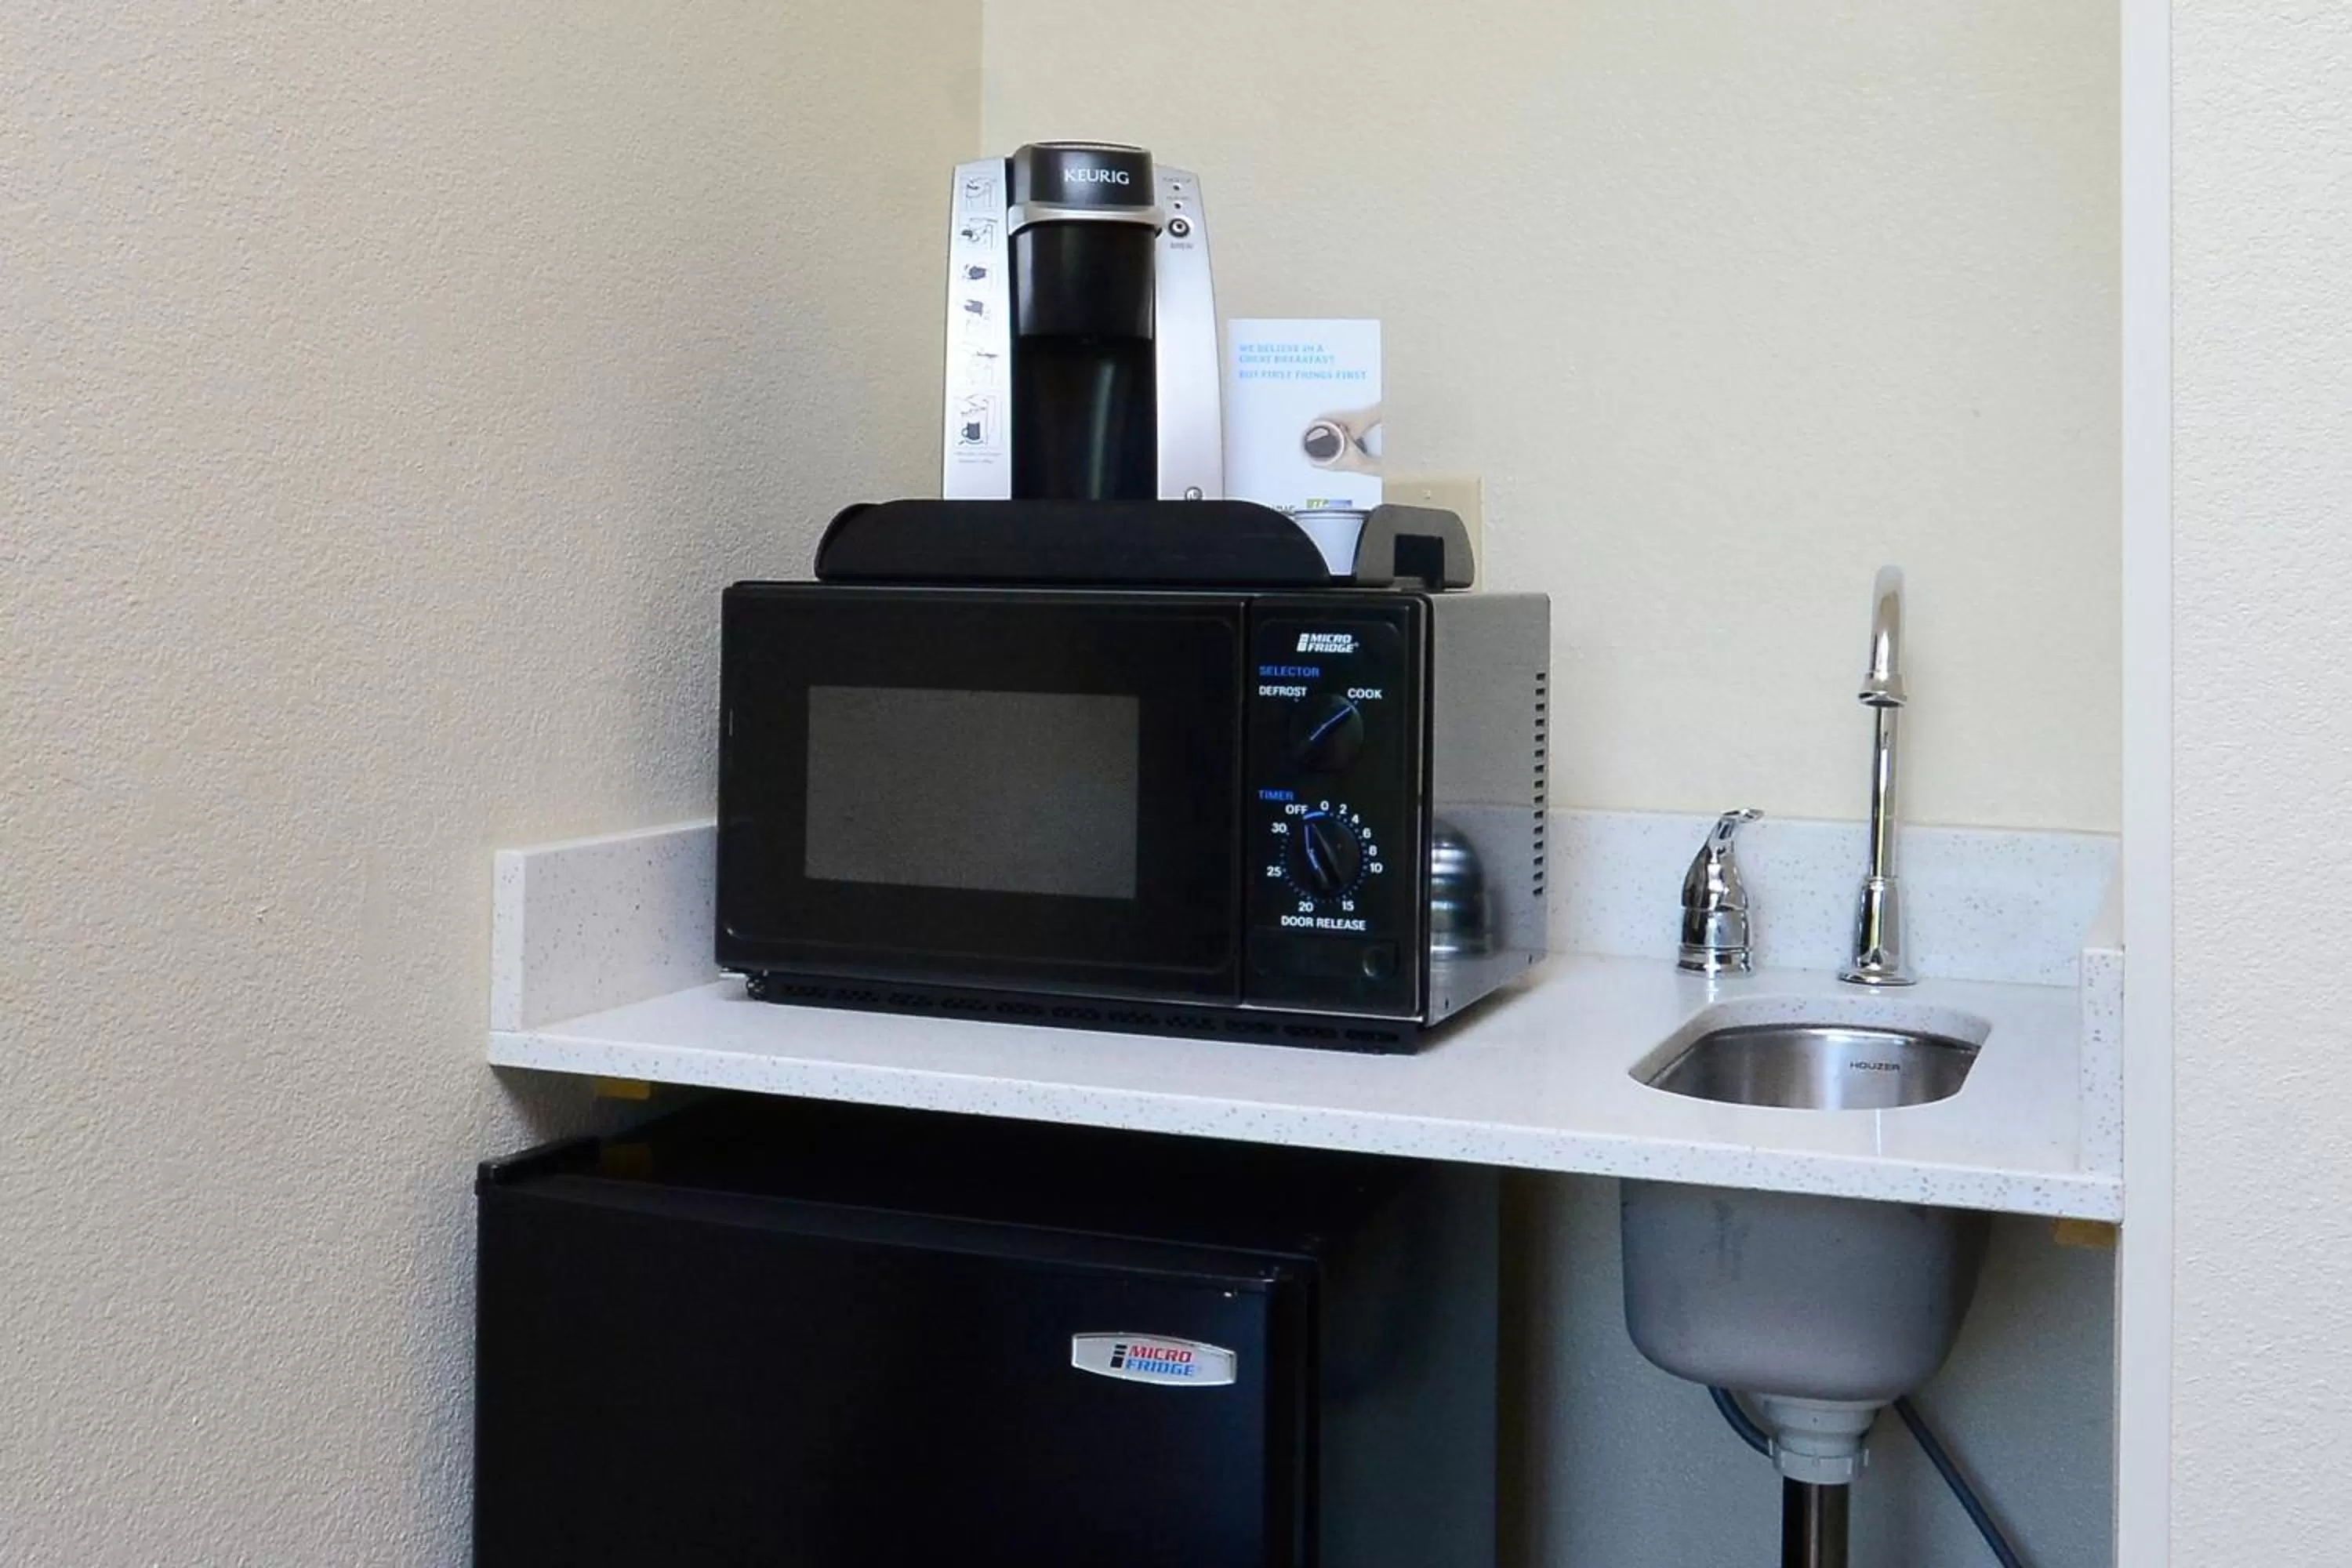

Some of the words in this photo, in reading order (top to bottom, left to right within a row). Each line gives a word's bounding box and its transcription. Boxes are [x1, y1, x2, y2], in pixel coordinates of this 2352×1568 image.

[1064, 169, 1130, 185] KEURIG
[1335, 369, 1367, 380] FIRST
[1310, 633, 1352, 643] MICRO
[1308, 642, 1355, 653] FRIDGE
[1259, 666, 1320, 677] SELECTOR
[1258, 685, 1307, 697] DEFROST
[1347, 688, 1383, 700] COOK
[1258, 790, 1294, 800] TIMER
[1285, 804, 1308, 815] OFF
[1320, 800, 1330, 811] 0
[1339, 804, 1348, 815] 2
[1351, 815, 1359, 825] 4
[1271, 822, 1287, 833] 30
[1363, 829, 1371, 839] 6
[1369, 845, 1377, 856] 8
[1266, 866, 1283, 877] 25
[1370, 862, 1384, 873] 10
[1298, 902, 1314, 913] 20
[1341, 901, 1355, 912] 15
[1281, 916, 1314, 927] DOOR
[1317, 918, 1367, 931] RELEASE
[1849, 1061, 1900, 1071] HOUZER
[1129, 1345, 1192, 1363] MICRO
[1126, 1359, 1194, 1376] FRIDGE
